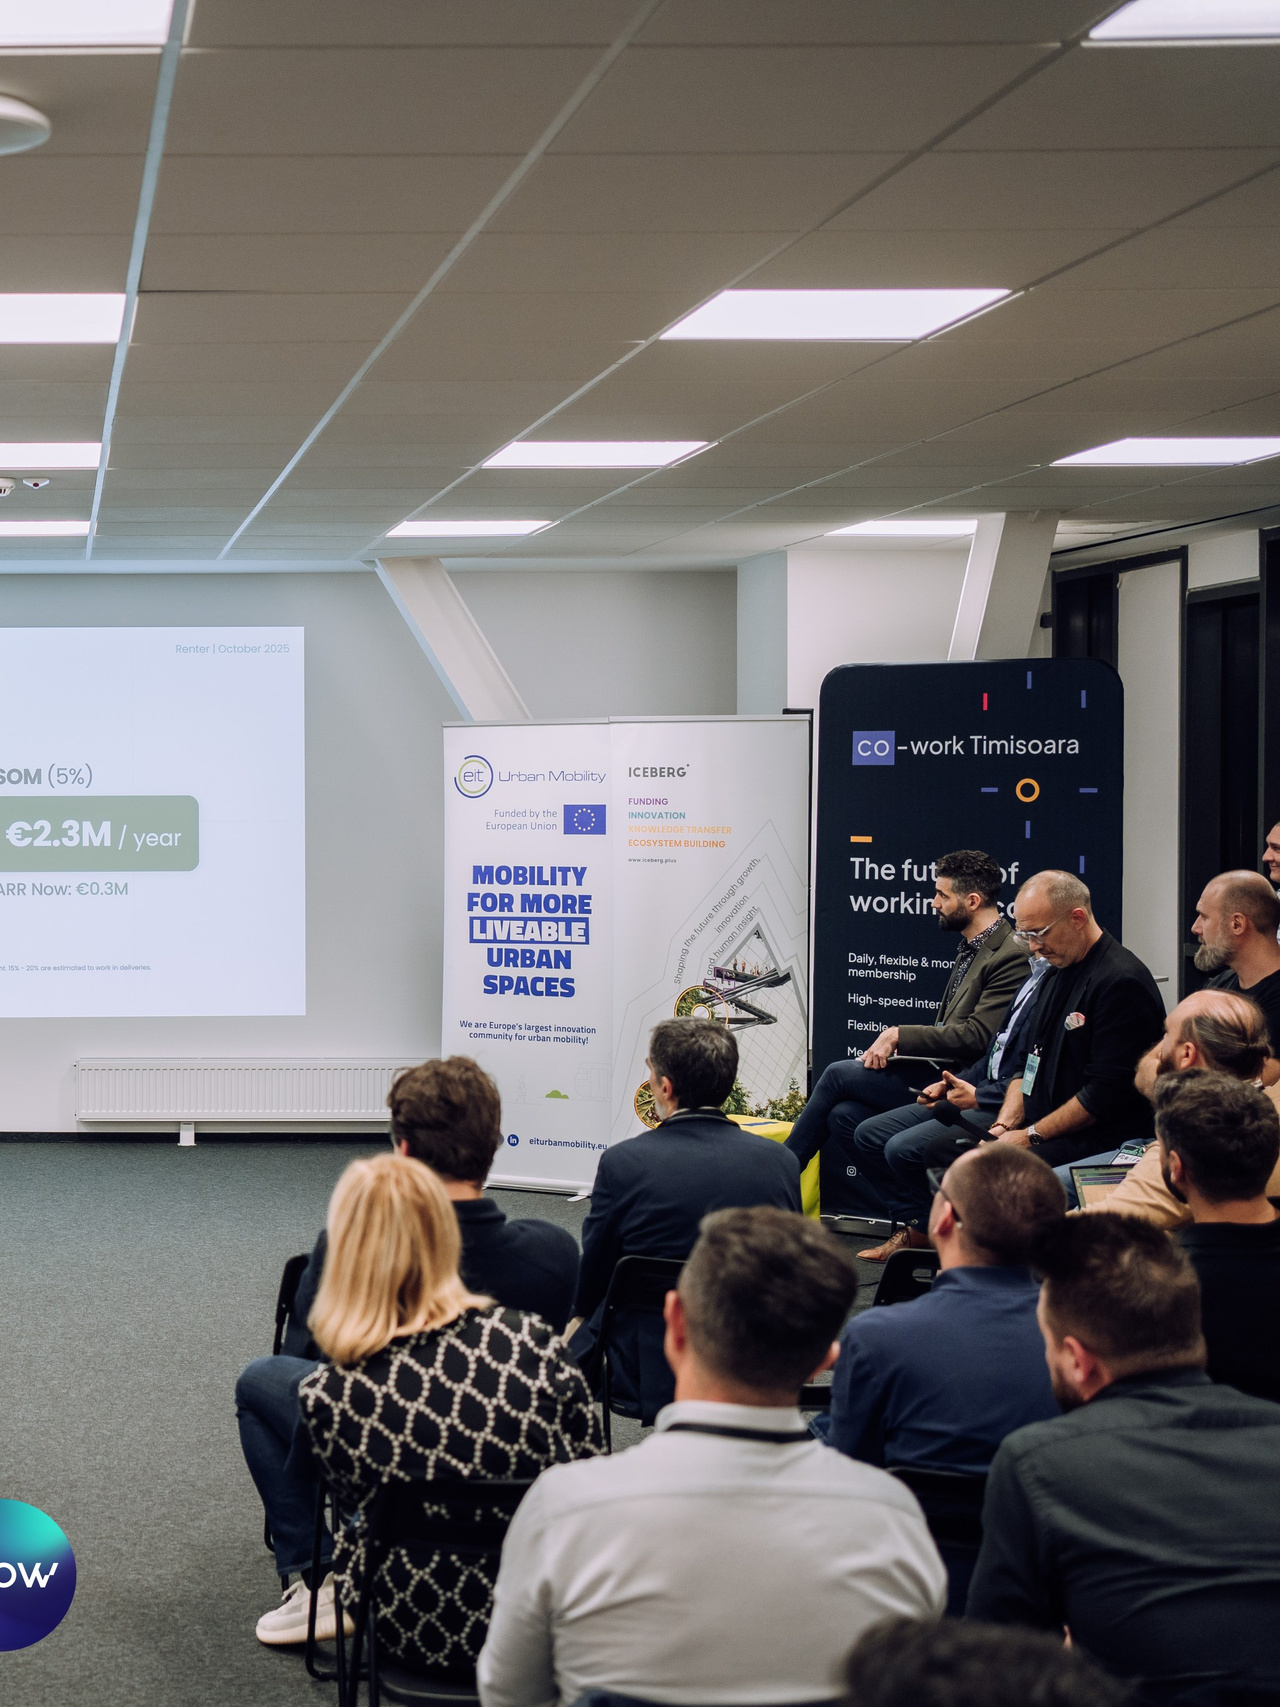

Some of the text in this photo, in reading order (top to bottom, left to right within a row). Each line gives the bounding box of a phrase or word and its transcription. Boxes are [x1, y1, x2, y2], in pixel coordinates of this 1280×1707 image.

[175, 644, 210, 654] Renter
[218, 643, 261, 654] October
[264, 643, 290, 654] 2025
[969, 734, 1080, 755] Timisoara
[47, 763, 93, 788] (5%)
[463, 769, 607, 784] eit Urban Mobility
[494, 809, 558, 820] Funded by the
[628, 811, 686, 820] INNOVATION
[486, 822, 558, 831] European Union
[628, 825, 732, 834] KNOWLEDGE TRANSFER
[5, 819, 182, 852] €2.3M / year
[628, 839, 726, 848] ECOSYSTEM BUILDING
[472, 865, 588, 886] MOBILITY
[849, 857, 896, 881] The
[901, 858, 937, 882] fut
[31, 882, 72, 896] Now:
[75, 882, 129, 896] €0.3M
[467, 892, 592, 914] FOR MORE
[849, 891, 937, 915] workin
[674, 857, 761, 985] Shaping the future through growth,
[714, 894, 749, 934] innovation
[472, 919, 586, 943] LIVEABLE
[707, 905, 760, 976] and human insight.
[486, 947, 572, 970] URBAN
[848, 952, 877, 966] Daily,
[879, 954, 919, 967] flexible
[920, 956, 929, 968] &
[53, 964, 87, 972] estimated
[95, 964, 111, 972] work
[112, 964, 119, 972] in
[119, 964, 152, 972] deliveries.
[848, 968, 917, 983] membership
[483, 974, 576, 998] SPACES
[847, 992, 913, 1008] High-speed
[459, 1020, 473, 1028] We
[489, 1021, 523, 1031] Europe's
[524, 1023, 552, 1033] largest
[554, 1024, 597, 1034] innovation
[847, 1019, 889, 1032] Flexible
[469, 1031, 589, 1046] community for urban mobility!
[529, 1137, 608, 1151] eiturbanmobility.eu
